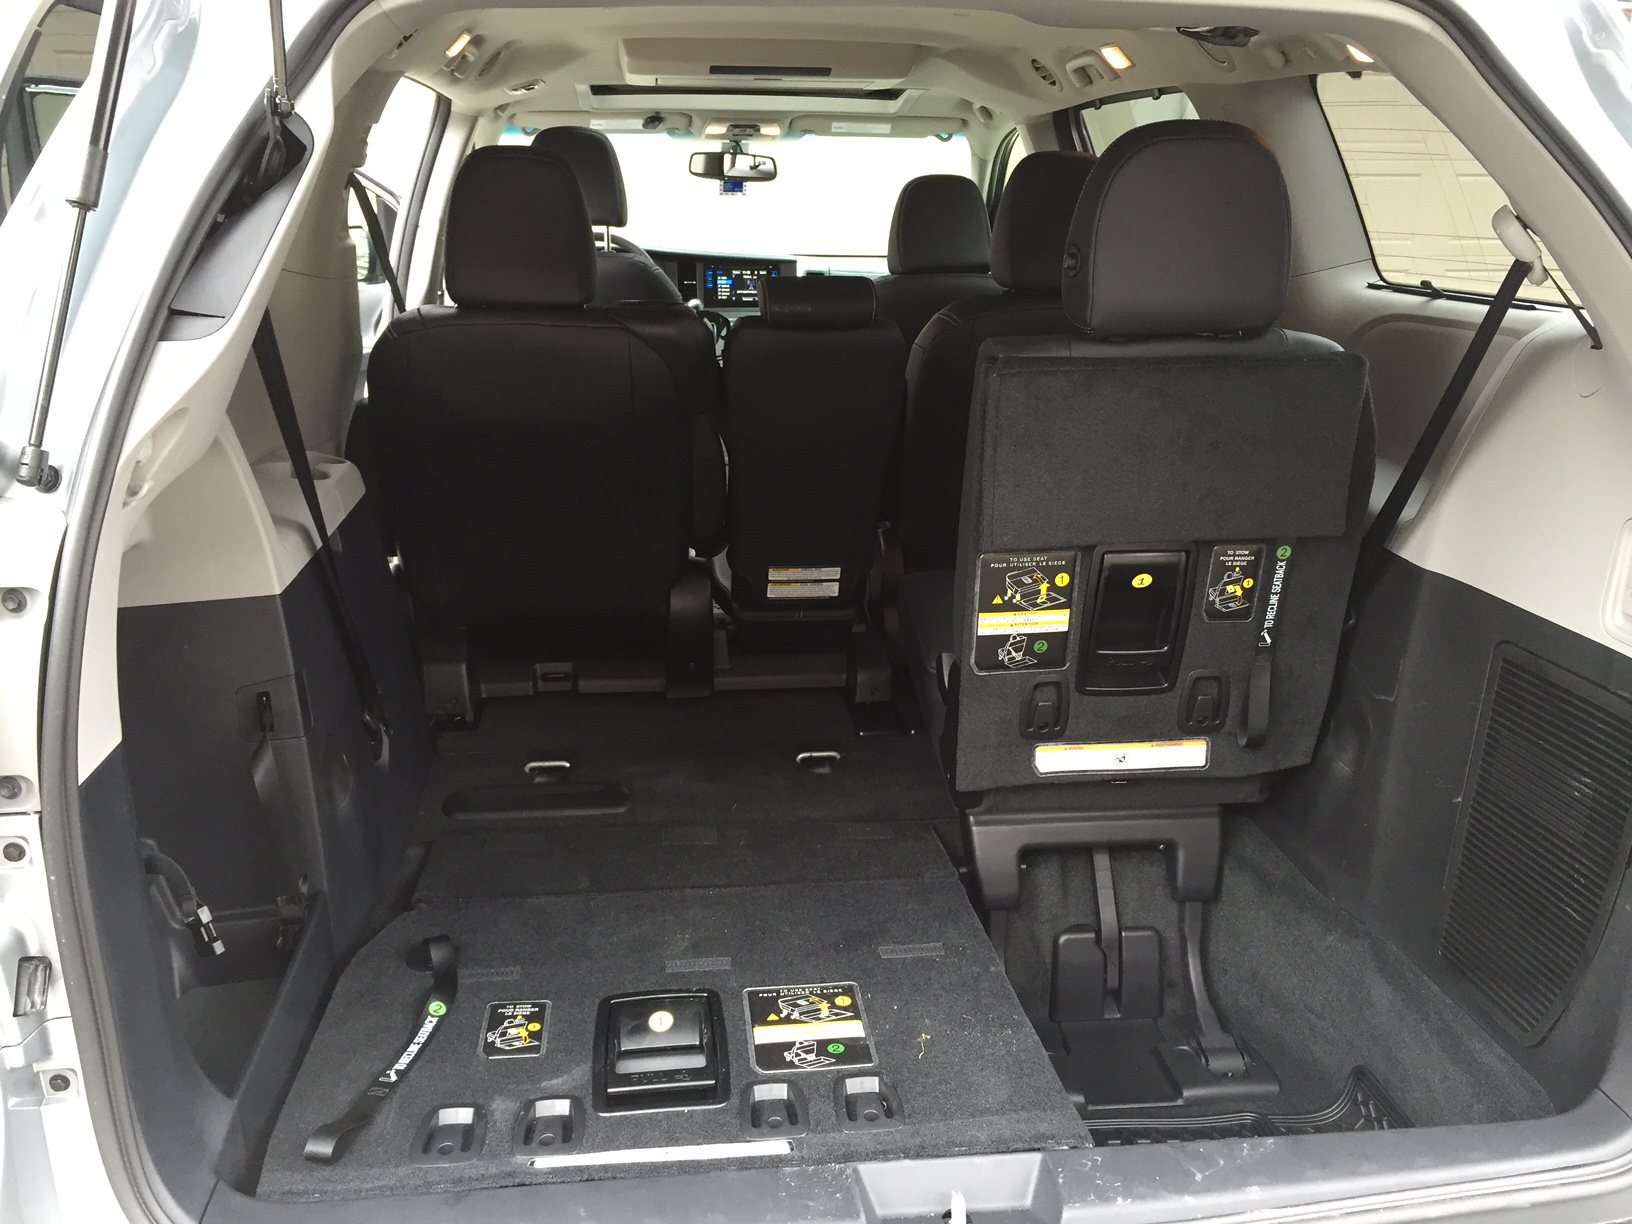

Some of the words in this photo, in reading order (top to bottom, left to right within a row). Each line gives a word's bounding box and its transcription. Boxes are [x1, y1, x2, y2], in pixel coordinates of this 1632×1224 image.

[1271, 560, 1287, 592] SEATBACK
[1266, 593, 1280, 620] RECLINE
[1264, 619, 1274, 628] TO
